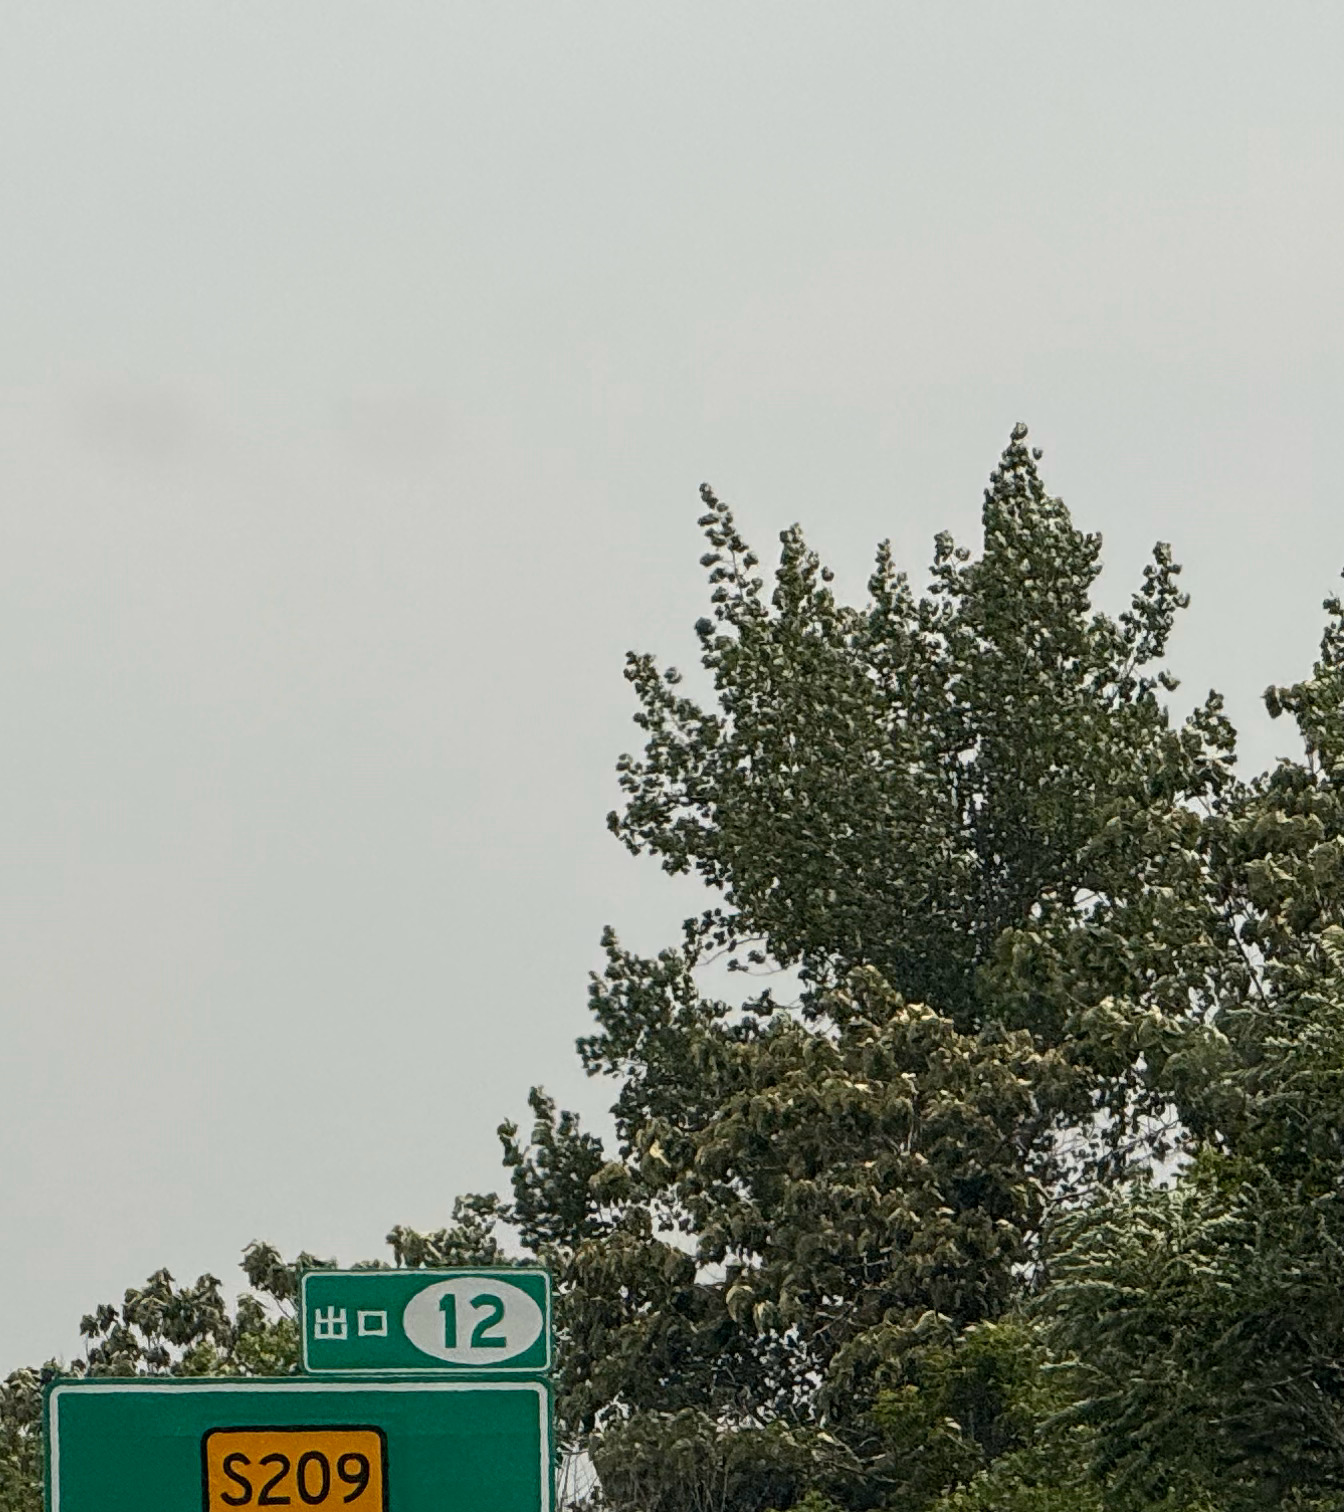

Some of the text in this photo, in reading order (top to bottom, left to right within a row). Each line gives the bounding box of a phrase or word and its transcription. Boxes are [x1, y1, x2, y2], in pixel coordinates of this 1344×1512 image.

[314, 1293, 507, 1349] 出口 12
[219, 1451, 371, 1506] S209
